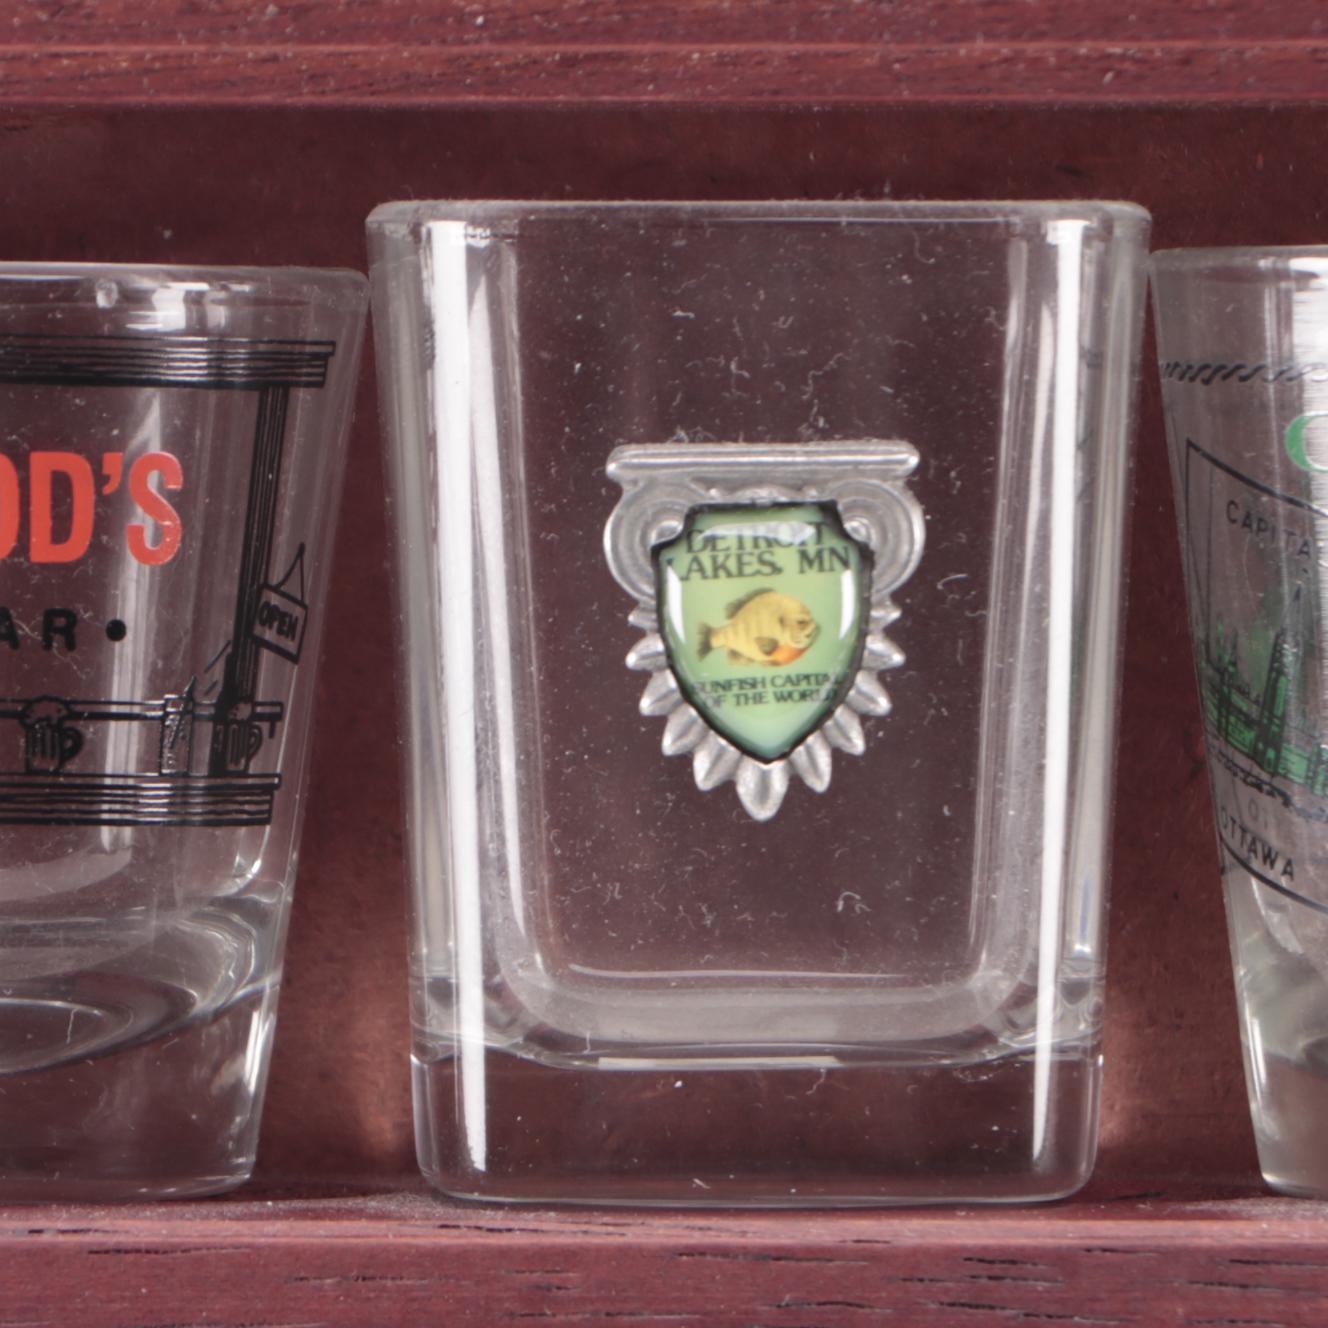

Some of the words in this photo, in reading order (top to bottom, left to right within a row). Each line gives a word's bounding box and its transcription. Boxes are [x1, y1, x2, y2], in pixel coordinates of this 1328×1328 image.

[685, 521, 828, 554] DETRT
[1226, 500, 1328, 568] CAPITA
[798, 546, 852, 574] MN
[258, 600, 298, 642] OPEN
[734, 691, 769, 706] THE
[772, 686, 838, 704] WORD
[770, 671, 844, 690] CAPITA
[1220, 806, 1295, 883] OTTAWA
